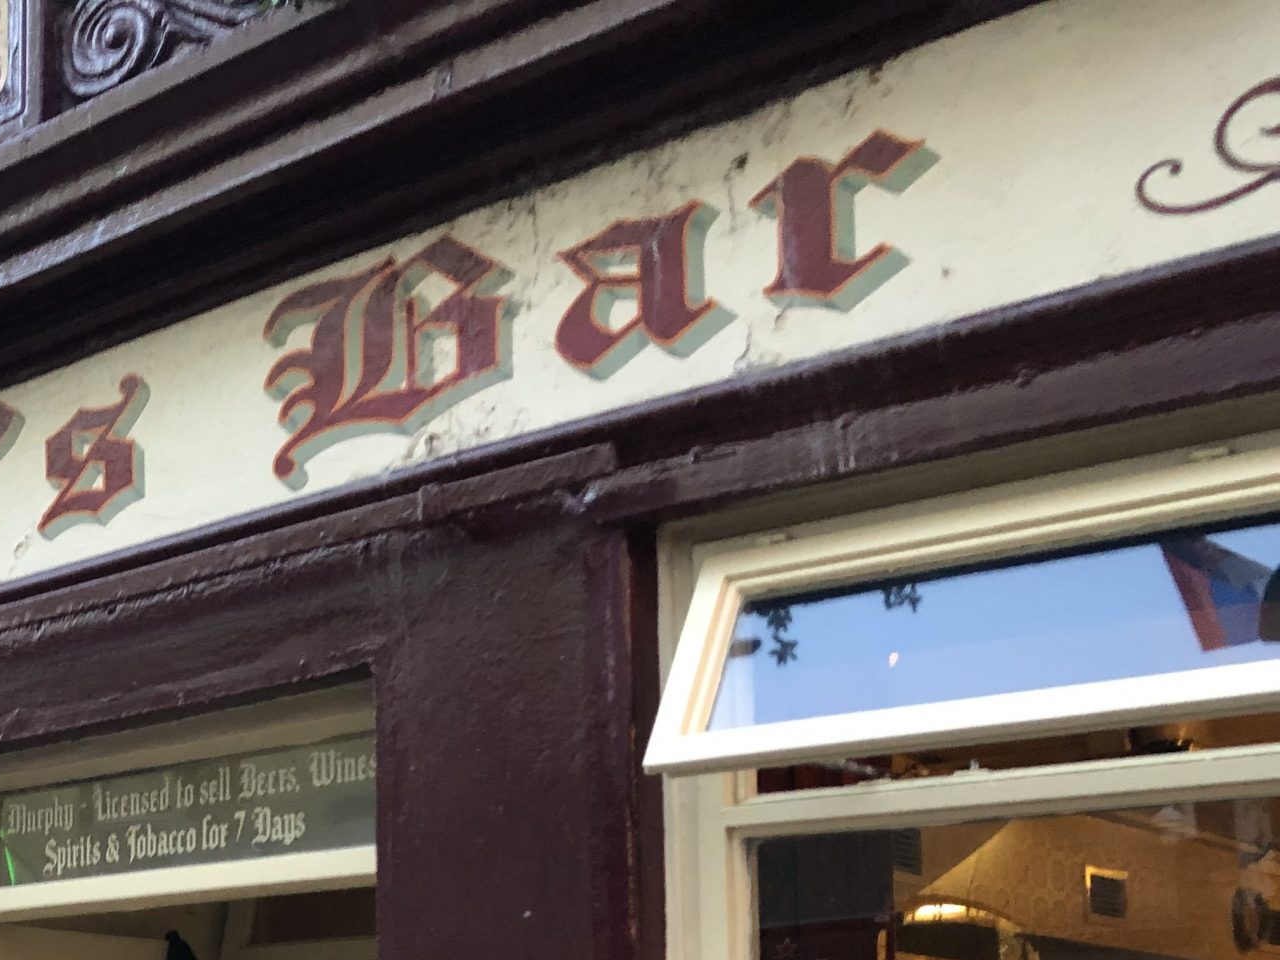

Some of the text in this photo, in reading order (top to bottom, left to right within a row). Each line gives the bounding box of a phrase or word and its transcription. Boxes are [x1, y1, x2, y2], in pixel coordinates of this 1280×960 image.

[263, 128, 942, 490] Bar
[6, 797, 75, 836] Murphy
[92, 775, 171, 821] Licensed
[176, 776, 195, 808] to
[199, 765, 231, 805] sell
[42, 806, 307, 877] Spirits & Tobacco for 7 Days
